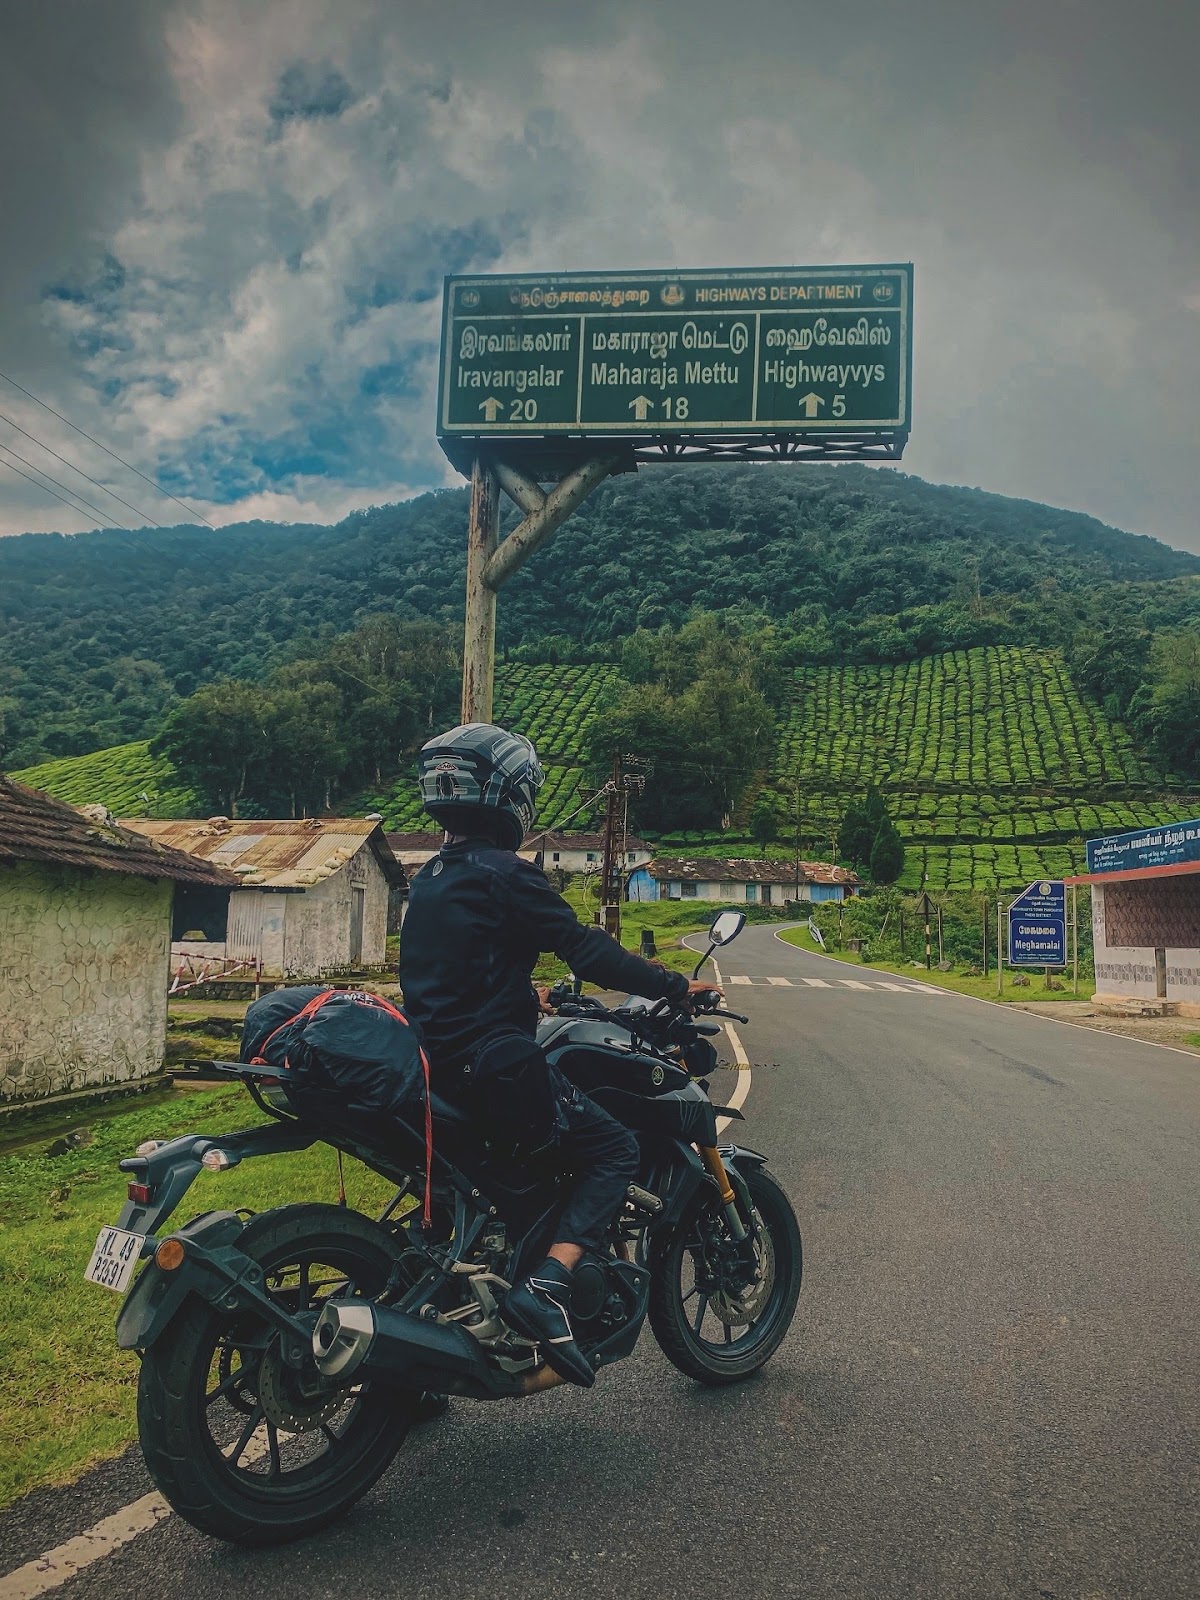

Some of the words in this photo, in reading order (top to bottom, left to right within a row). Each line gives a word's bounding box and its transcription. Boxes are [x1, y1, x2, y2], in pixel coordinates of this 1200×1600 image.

[510, 285, 650, 309] நெடுஞ்சாலைத்துறை
[695, 286, 767, 303] HIGHWAYS
[768, 284, 863, 301] DEPARTMENT
[460, 325, 572, 359] இரவங்கலார்
[592, 330, 678, 359] மகாராஜா
[682, 320, 748, 355] மெட்டு
[765, 317, 892, 355] ஹைவேவிஸ்
[457, 364, 563, 392] Iravangalar
[591, 362, 678, 390] Maharaja
[685, 361, 739, 385] Mettu
[764, 360, 885, 387] Highwayvys
[509, 399, 537, 422] 20
[661, 397, 689, 420] 18
[832, 394, 846, 417] 5
[1015, 940, 1060, 951] Meghamalai
[100, 1230, 118, 1256] KL
[119, 1235, 136, 1262] 49
